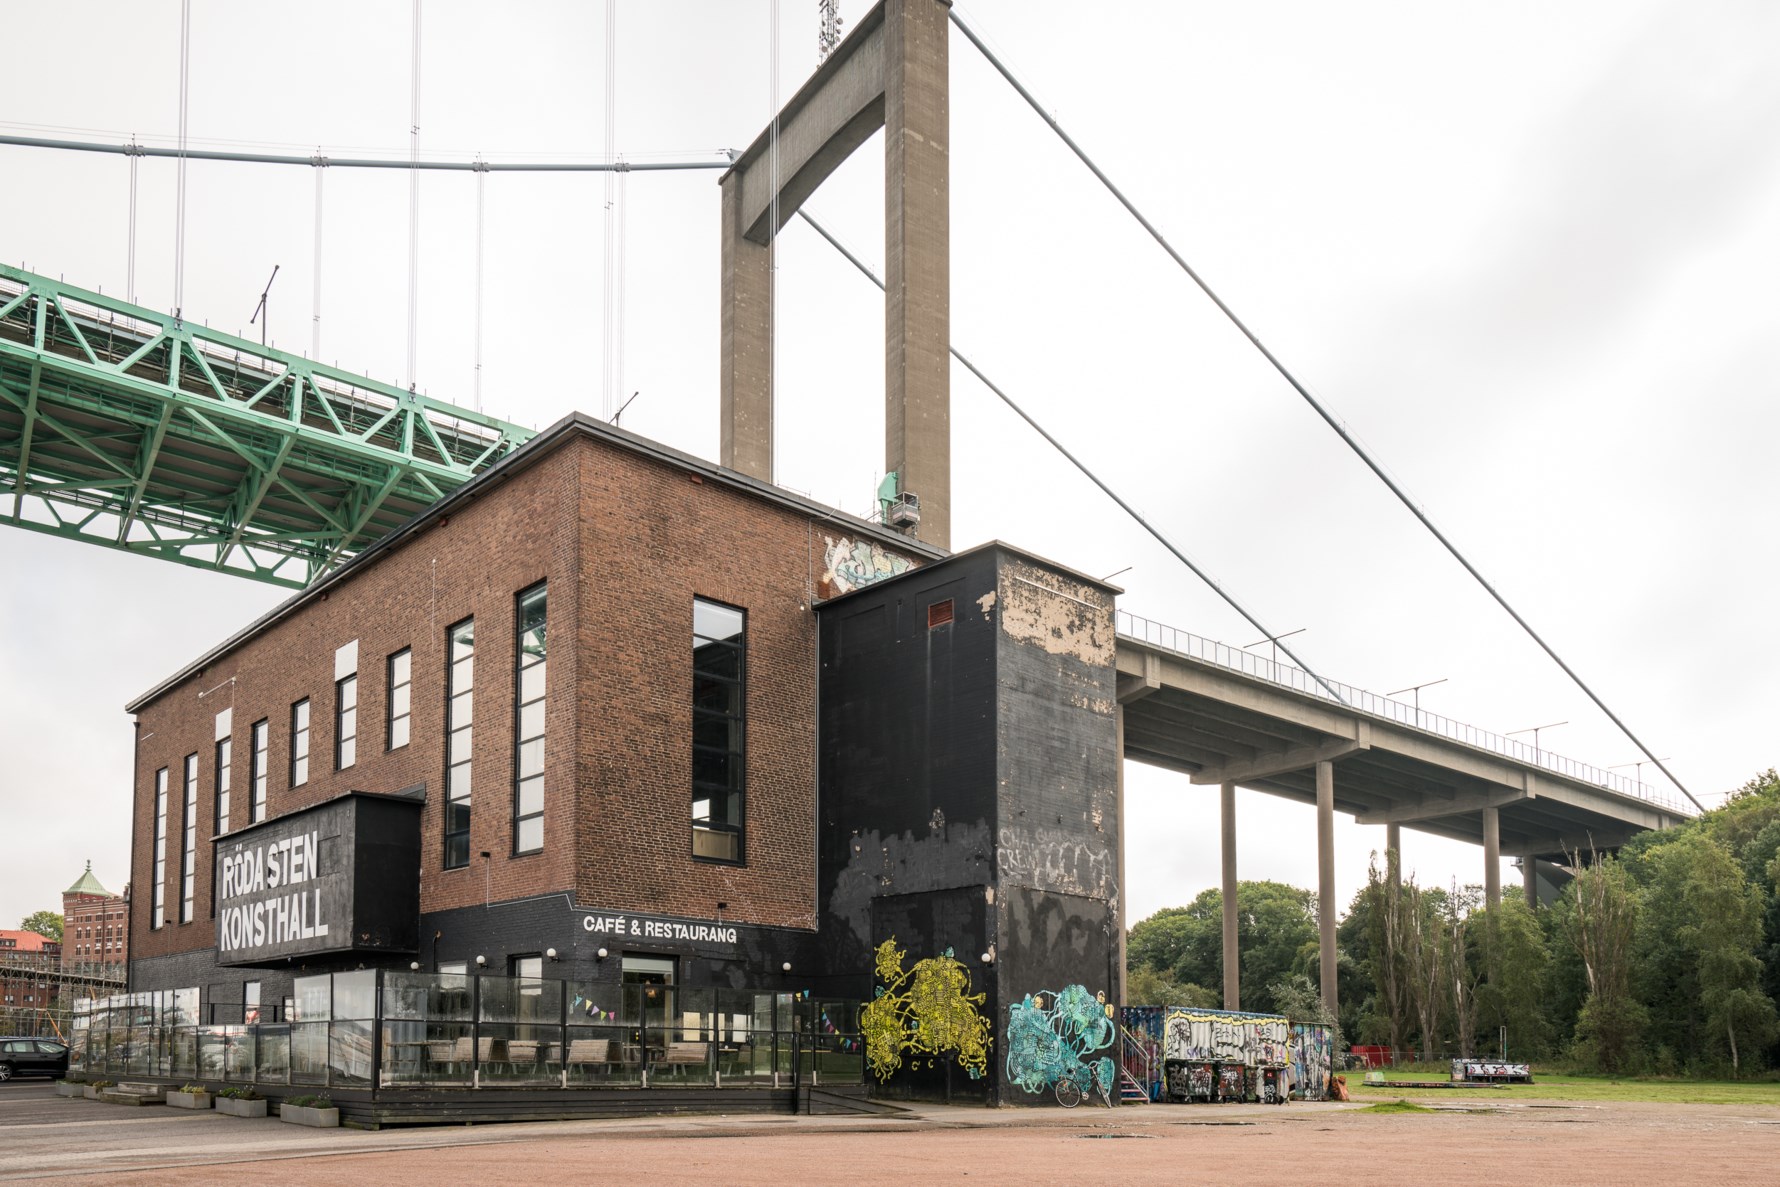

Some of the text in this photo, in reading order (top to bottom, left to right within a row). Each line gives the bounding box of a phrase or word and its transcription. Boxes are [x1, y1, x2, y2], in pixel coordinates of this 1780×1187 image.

[222, 831, 318, 899] RÖDA STEN
[221, 889, 329, 951] KONSTHALL
[583, 915, 737, 943] CAFÉ & RESTAURANG
